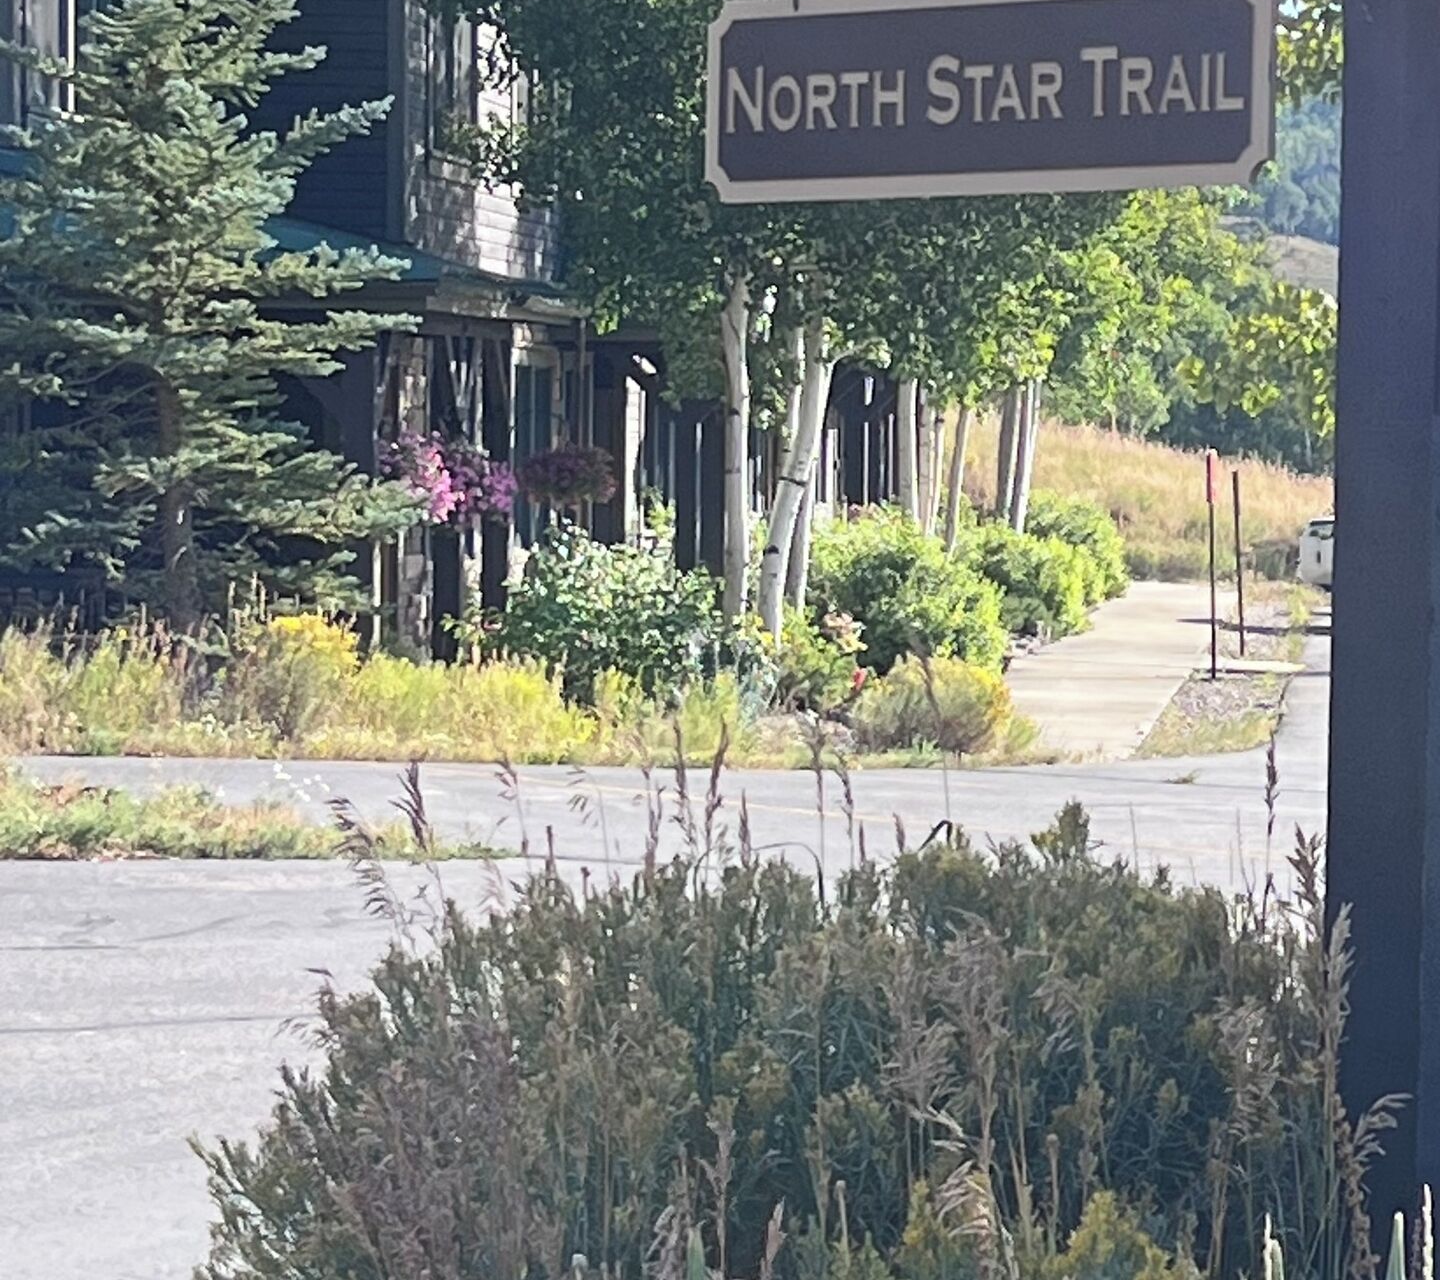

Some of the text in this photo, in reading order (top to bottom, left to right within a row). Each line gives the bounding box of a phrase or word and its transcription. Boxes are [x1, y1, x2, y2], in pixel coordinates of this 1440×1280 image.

[725, 45, 1246, 134] NORTH STAR TRAIL
